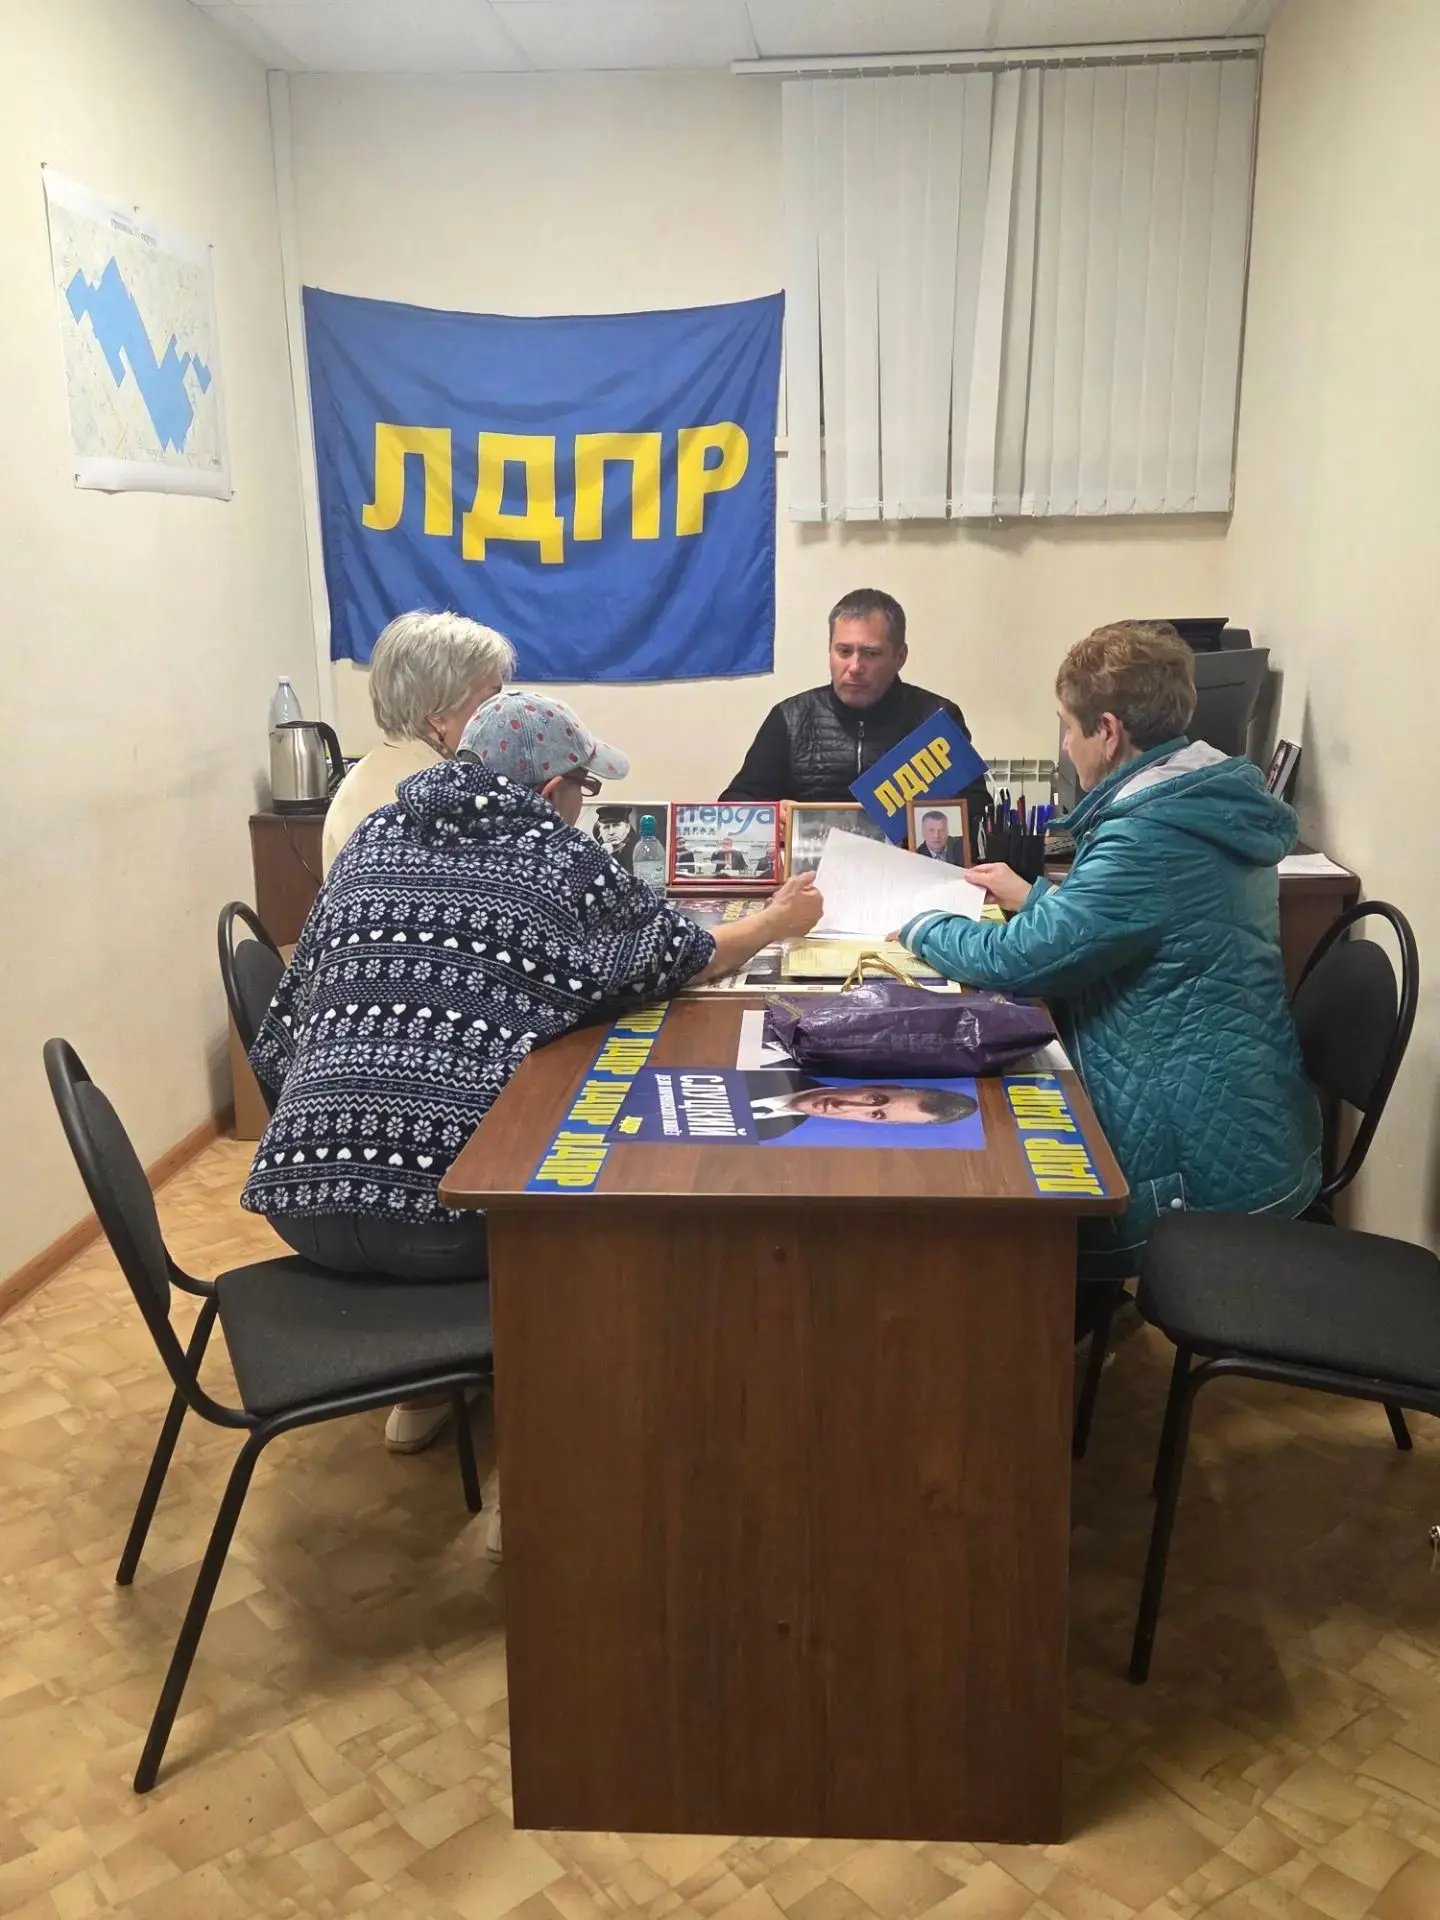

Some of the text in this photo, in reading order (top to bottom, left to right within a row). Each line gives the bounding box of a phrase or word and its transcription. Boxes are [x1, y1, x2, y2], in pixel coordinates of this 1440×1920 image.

[362, 421, 749, 563] ЛДПР
[873, 736, 953, 818] ЛДПР
[593, 1037, 655, 1075] ЛДПР
[567, 1080, 632, 1125] ЛДПР
[678, 1074, 747, 1136] СЛУЦКИЙ
[1007, 1085, 1077, 1132] ЛДПР
[535, 1131, 611, 1187] ЛДПР
[1024, 1138, 1104, 1195] ЛДПР
